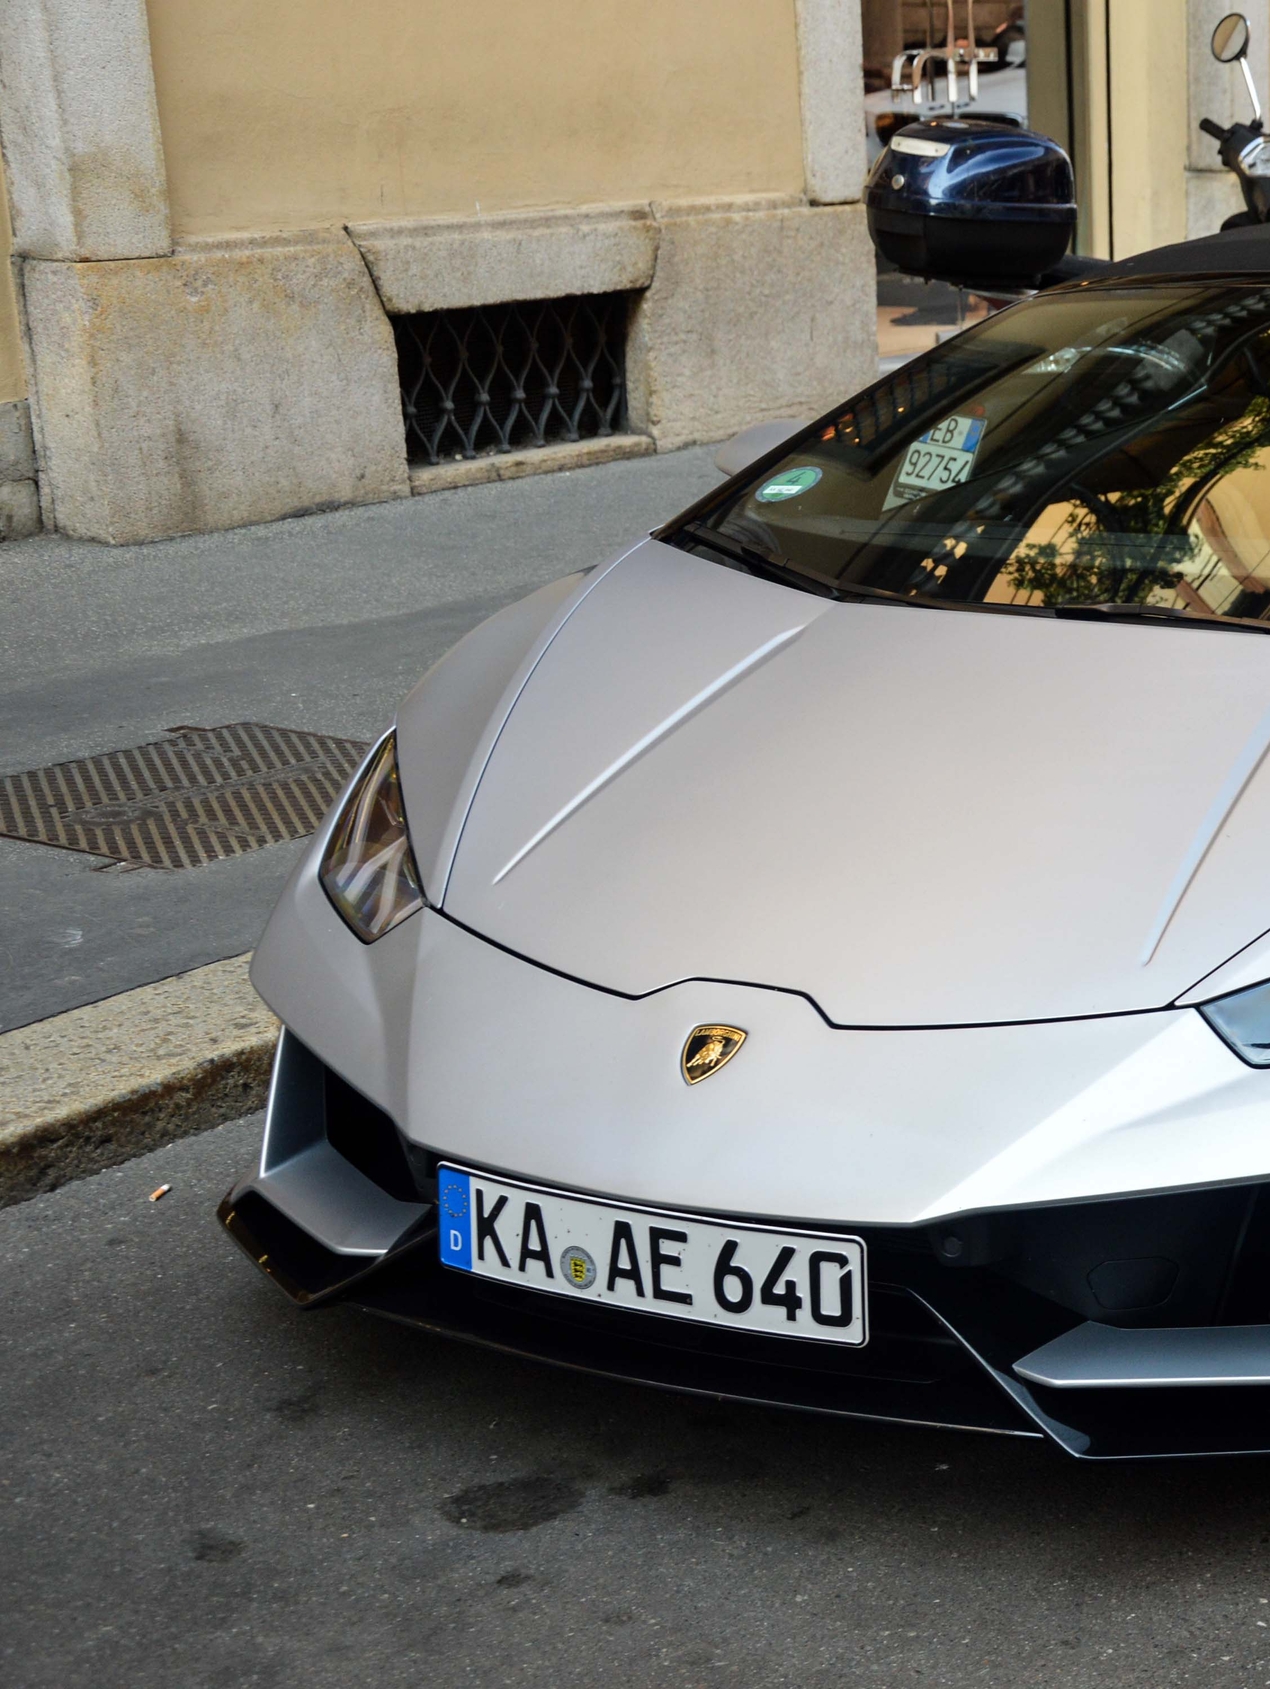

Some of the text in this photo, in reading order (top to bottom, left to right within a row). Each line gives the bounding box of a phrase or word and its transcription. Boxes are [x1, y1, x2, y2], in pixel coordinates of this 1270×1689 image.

[905, 449, 969, 484] 92754
[451, 1230, 462, 1251] D
[475, 1188, 554, 1279] KA
[606, 1220, 693, 1306] AE
[714, 1239, 853, 1328] 640
